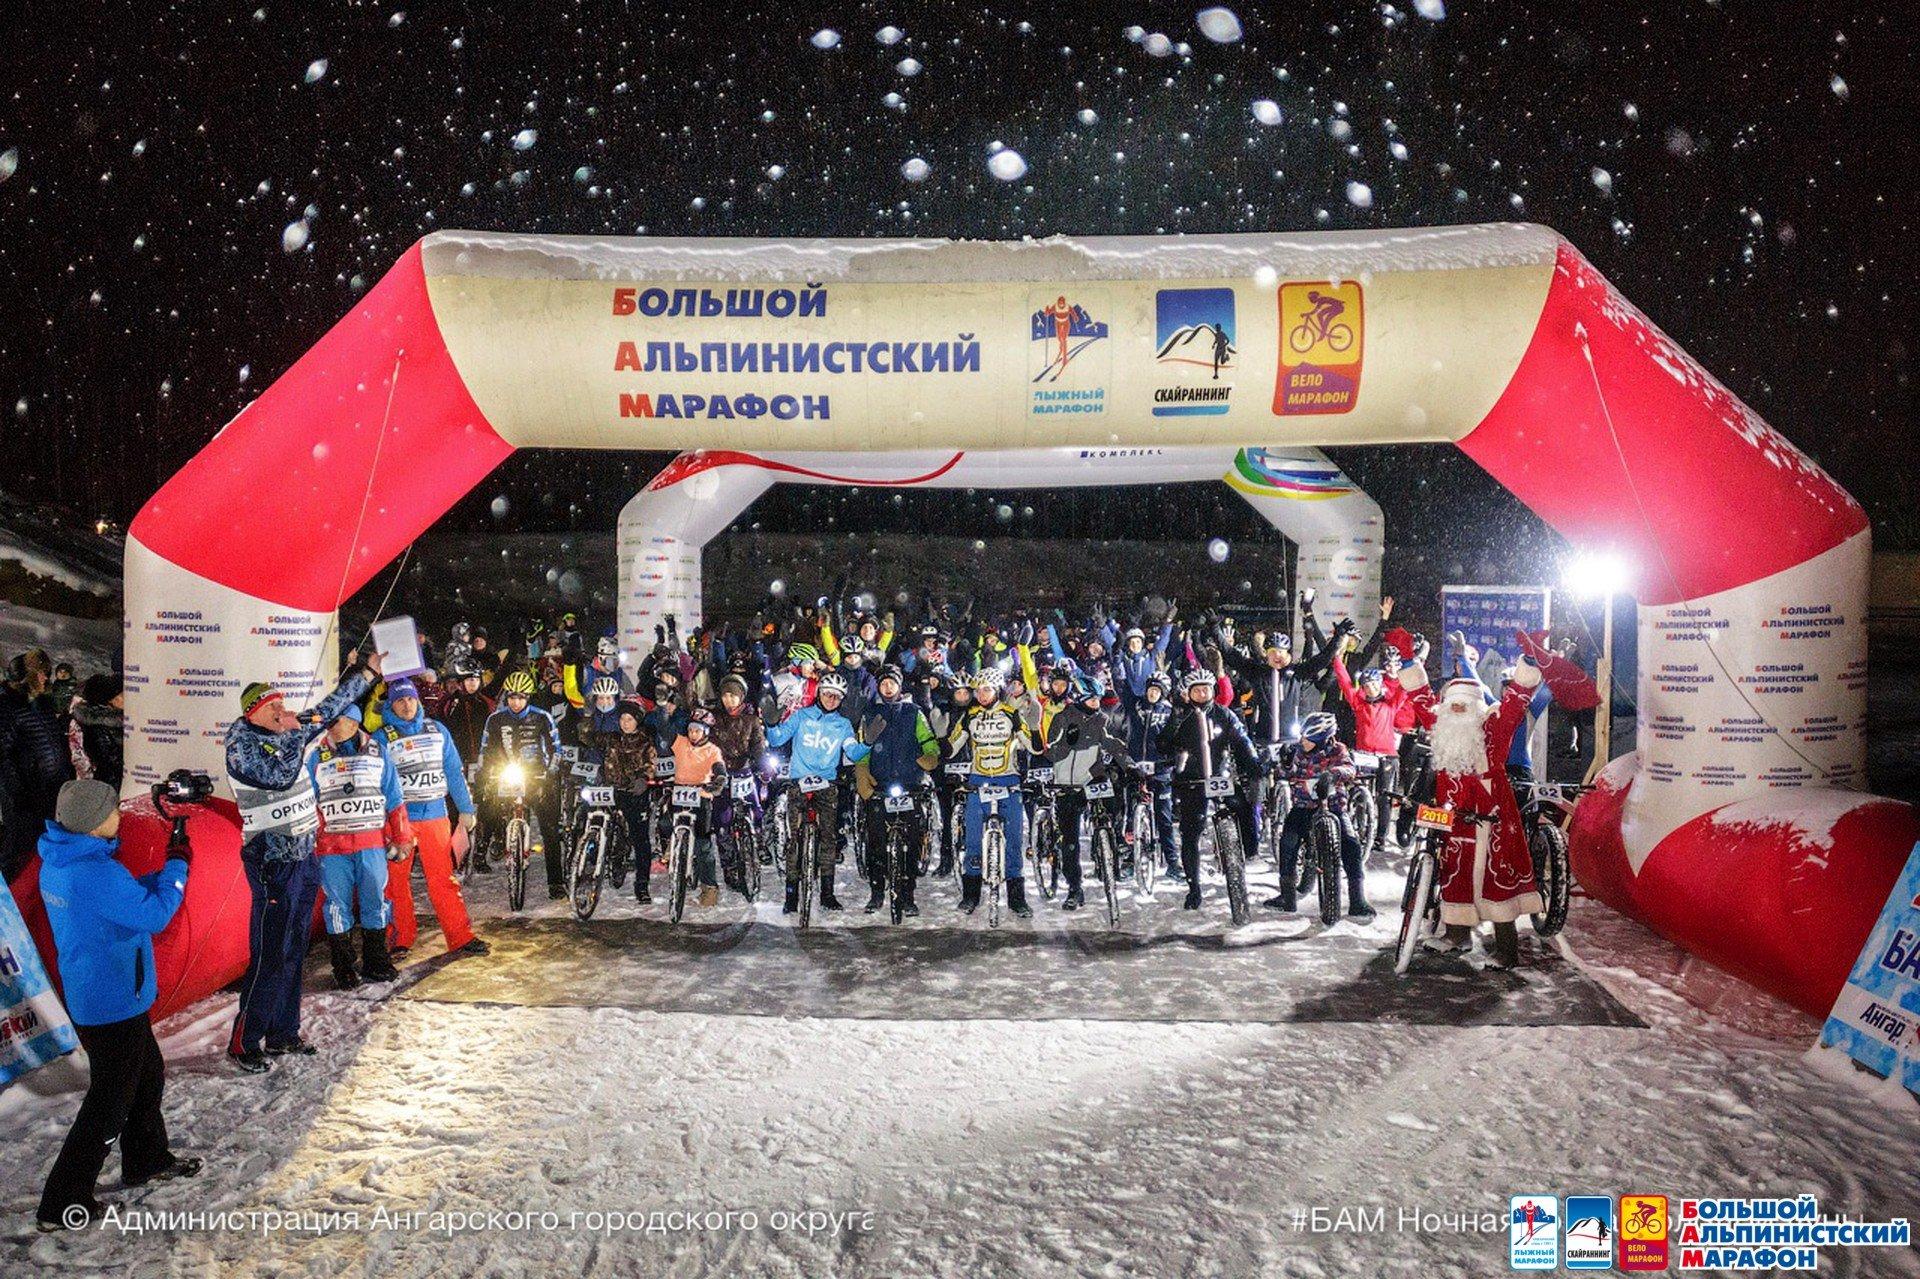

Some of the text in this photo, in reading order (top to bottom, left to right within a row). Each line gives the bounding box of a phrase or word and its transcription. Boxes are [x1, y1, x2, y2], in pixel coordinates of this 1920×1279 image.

[612, 282, 828, 318] БОЛЬШОЙ
[614, 333, 981, 374] АЛЬПИНИСТСКИЙ
[1291, 373, 1323, 387] ВЕЛО
[1033, 387, 1105, 400] ЛЫЖНЫЙ
[1154, 386, 1232, 403] СКАЙРАННИНГ
[1288, 391, 1349, 405] МАРАФОН
[619, 392, 831, 420] МАРАФОН
[1033, 403, 1104, 414] МАРАФОН
[157, 610, 202, 620] БОЛЬШОЙ
[1781, 604, 1832, 615] БОЛЬШОЙ
[268, 615, 312, 624] БОЛЬШОЙ
[1762, 616, 1845, 629] АЛЬПИНИСТСКИЙ
[157, 635, 203, 644] МАРАФОН
[1780, 631, 1831, 640] МАРАФОН
[268, 639, 312, 647] МАРАФОН
[180, 668, 224, 676] БОЛЬШОЙ
[1755, 663, 1804, 672] БОЛЬШОЙ
[1738, 673, 1819, 683] АЛЬПИНИСТСКИЙ
[269, 680, 323, 689] ЛЬПИНИСТСКИЙ
[1755, 686, 1804, 694] МАРАФОН
[179, 689, 224, 697] МАРАФОН
[803, 730, 839, 755] sky
[804, 775, 823, 785] 43
[1210, 780, 1229, 791] 33
[591, 791, 611, 801] 115
[674, 790, 698, 801] 114
[1538, 786, 1559, 798] 62
[1422, 809, 1449, 823] 2018
